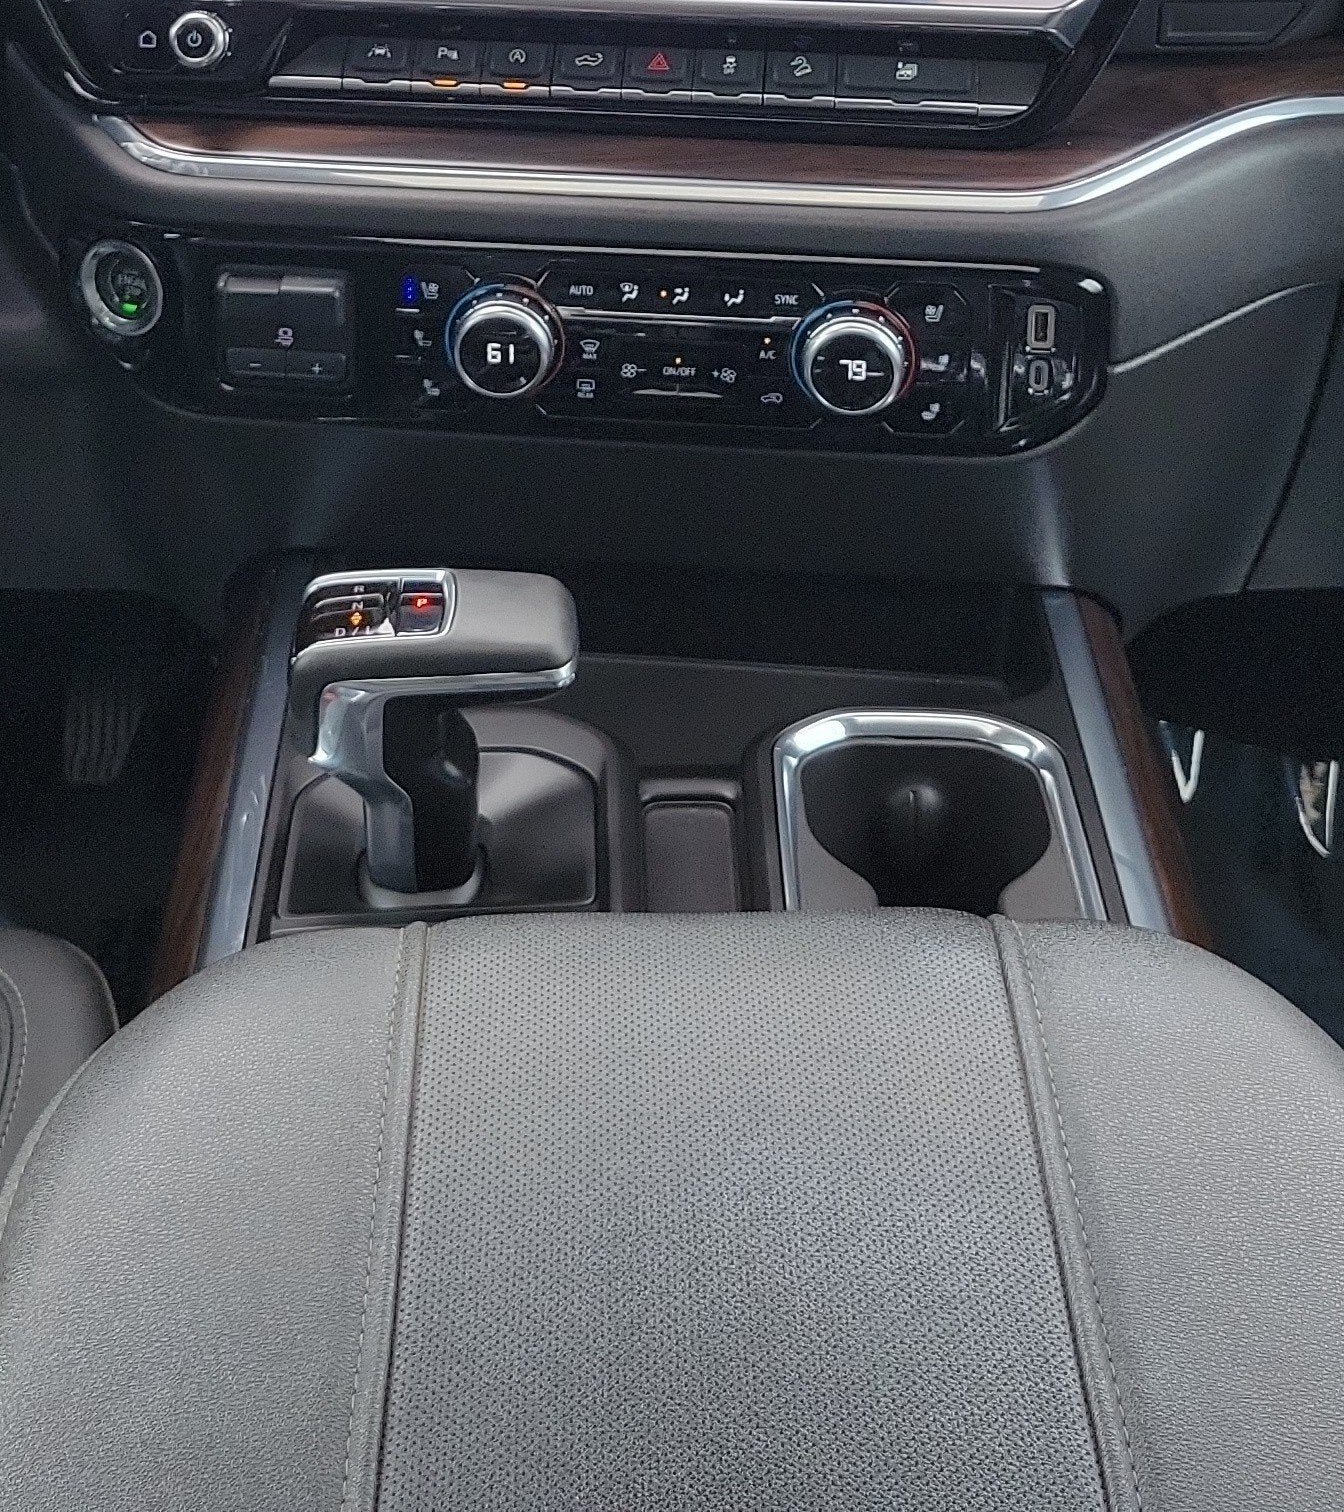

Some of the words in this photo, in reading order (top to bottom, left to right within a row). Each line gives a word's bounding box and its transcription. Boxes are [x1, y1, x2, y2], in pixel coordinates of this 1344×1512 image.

[569, 284, 594, 295] AUTO
[774, 294, 799, 305] SYNC
[487, 343, 515, 365] 61
[759, 349, 777, 360] A/C
[662, 366, 696, 377] ON/OFF
[839, 358, 867, 382] 79
[354, 585, 365, 593] R
[352, 601, 364, 610] N
[416, 598, 428, 608] P
[334, 628, 346, 637] D
